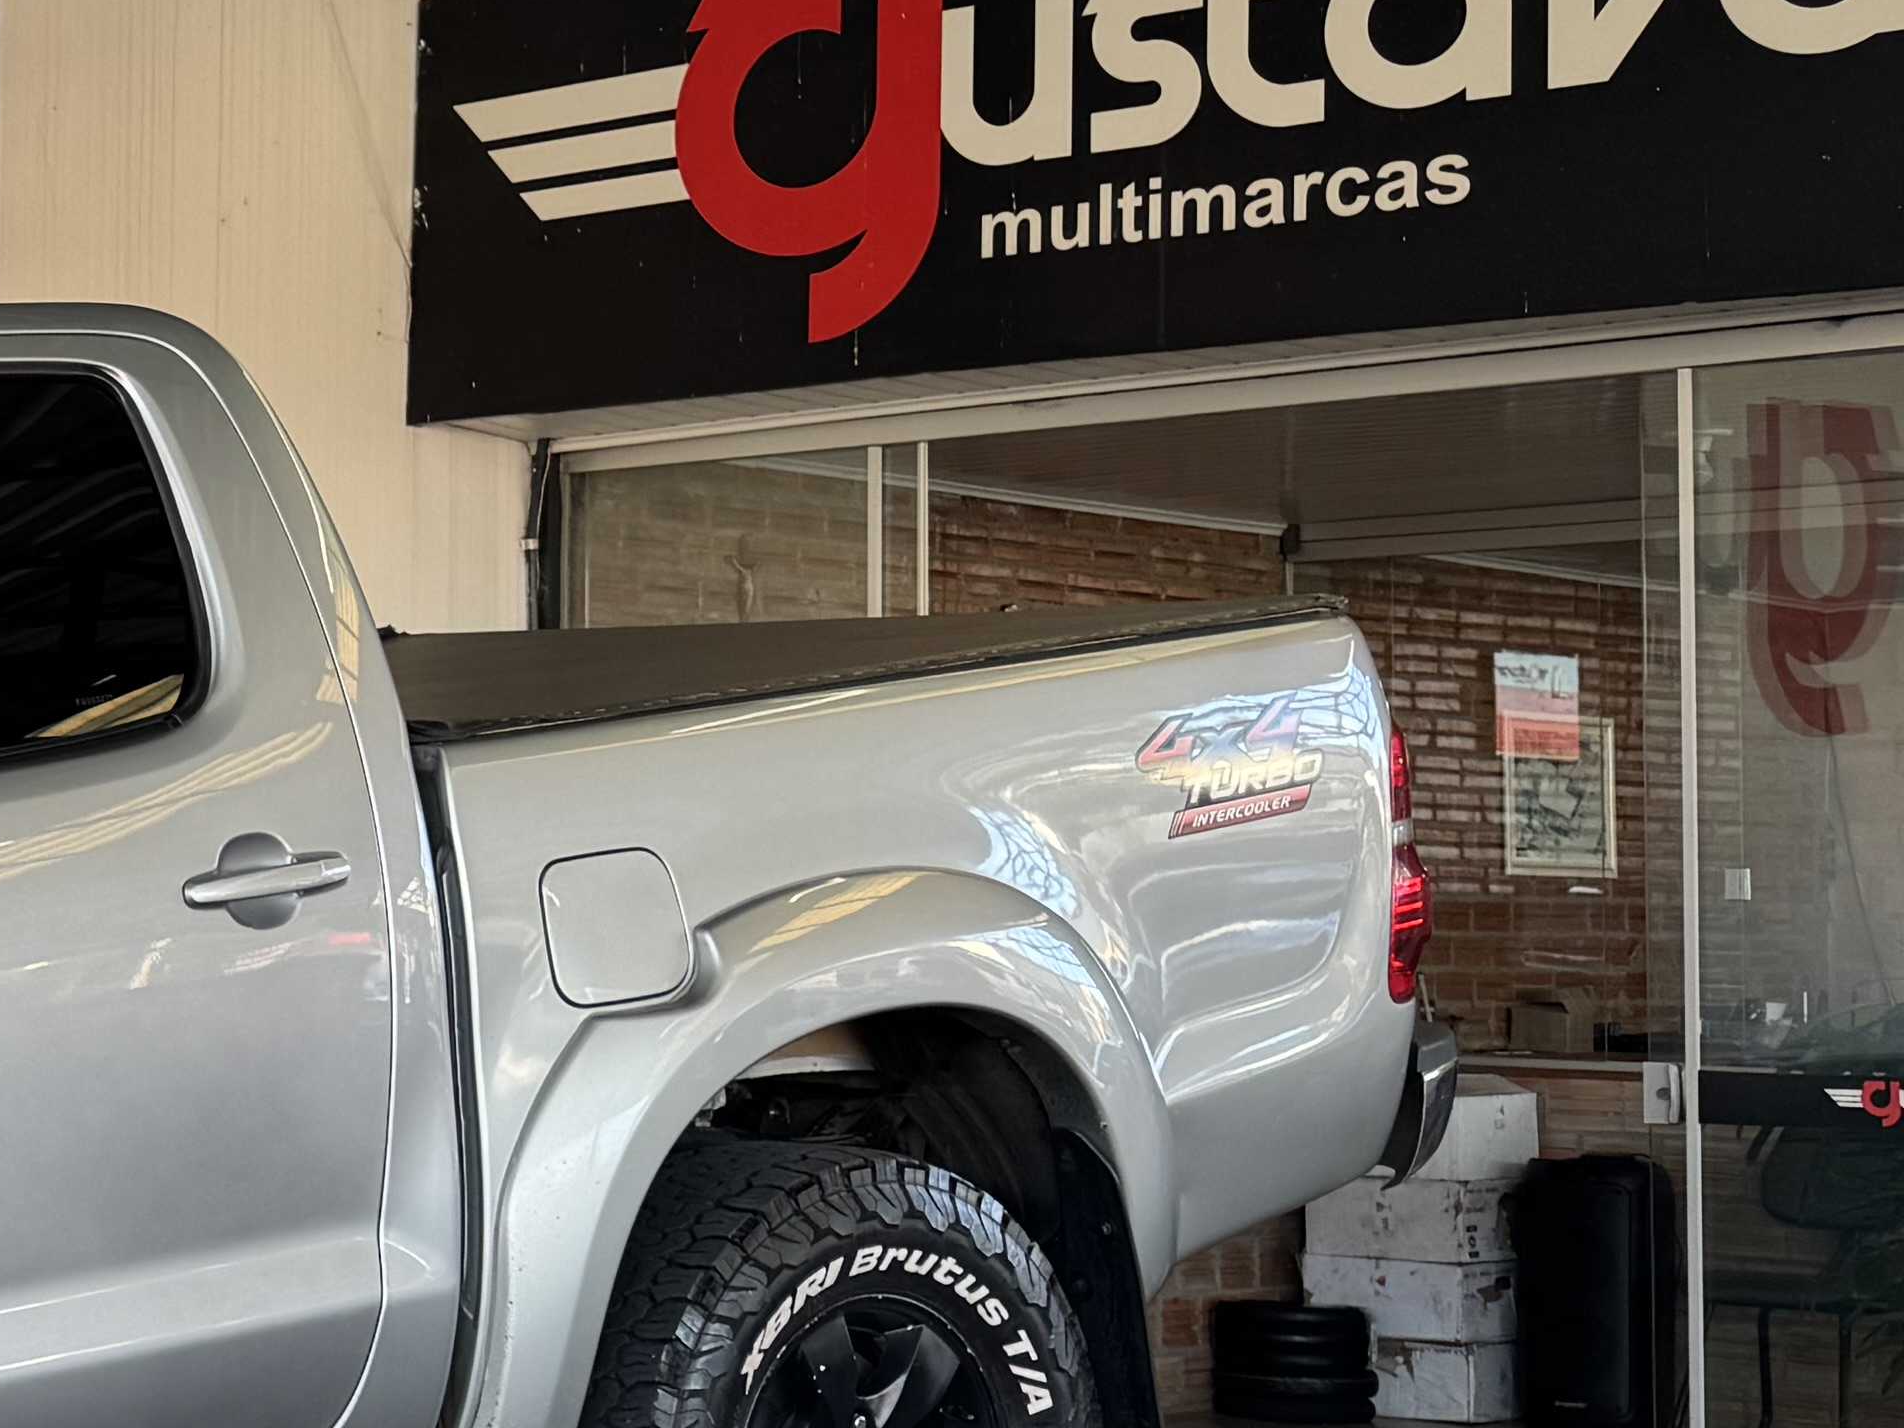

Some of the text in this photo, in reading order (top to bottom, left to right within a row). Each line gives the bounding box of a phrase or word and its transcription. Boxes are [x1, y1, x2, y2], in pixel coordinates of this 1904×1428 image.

[980, 154, 1471, 259] multimarcas
[1181, 747, 1325, 806] TURBO
[1192, 795, 1292, 828] INTERCOOLER
[740, 1244, 1054, 1417] XBRI Brutus T/A
